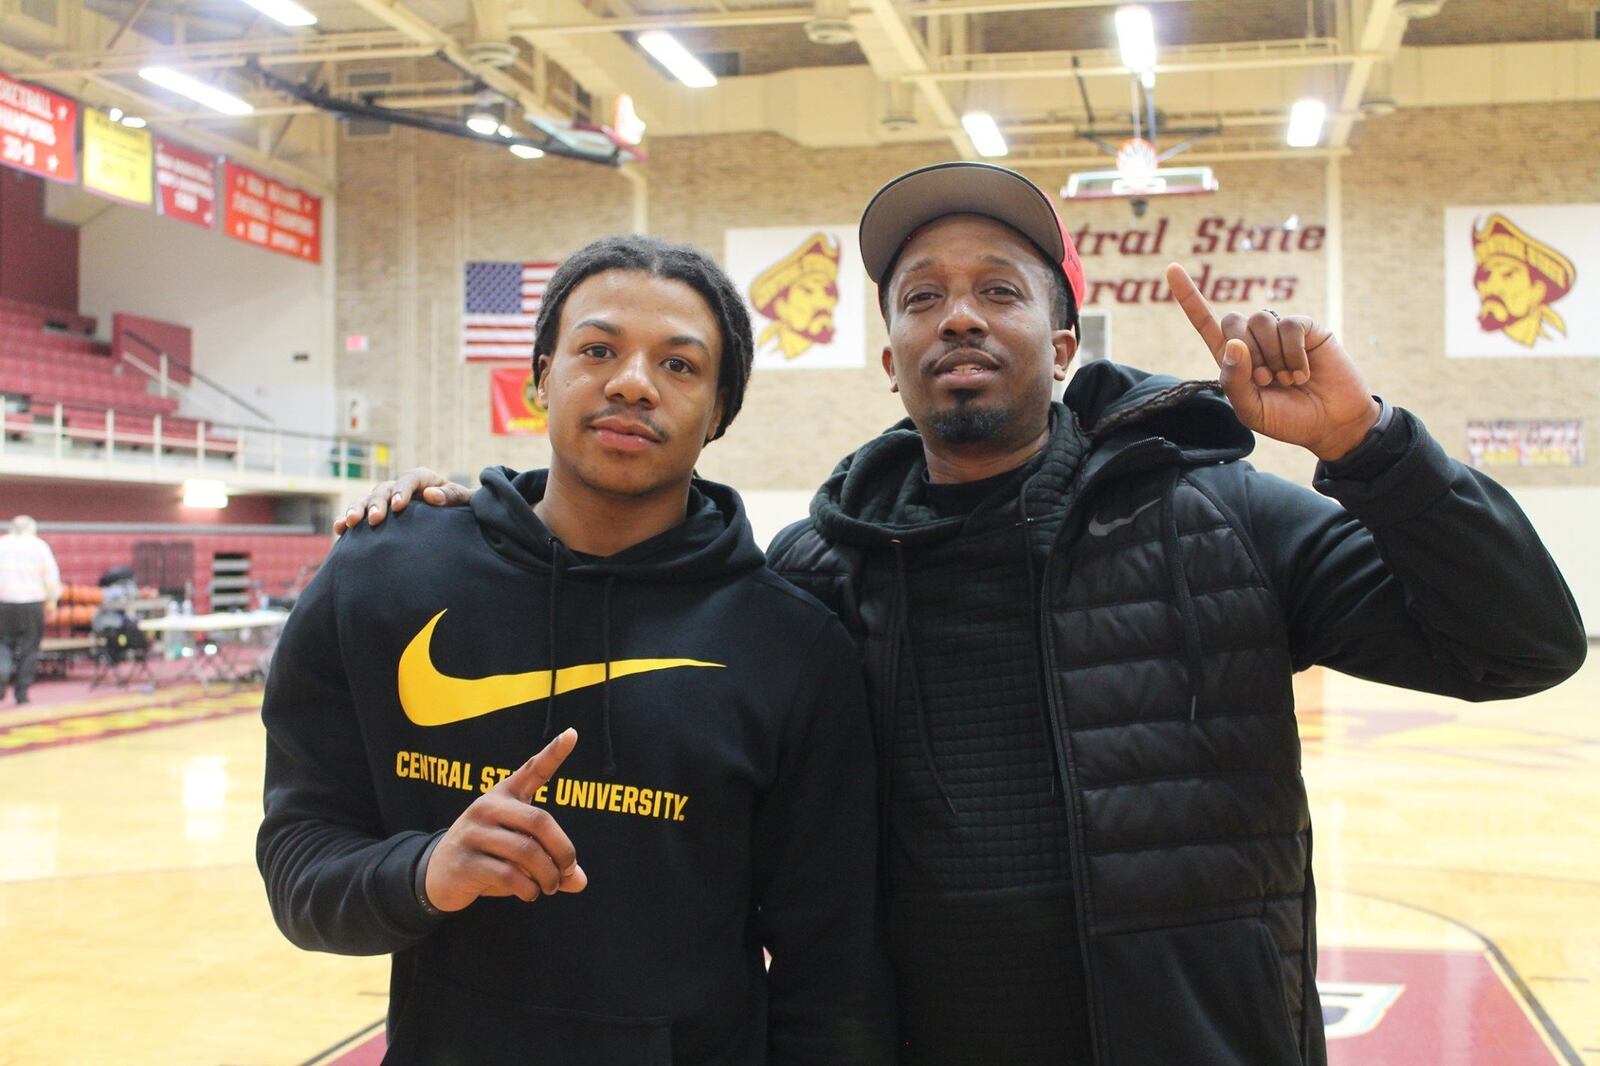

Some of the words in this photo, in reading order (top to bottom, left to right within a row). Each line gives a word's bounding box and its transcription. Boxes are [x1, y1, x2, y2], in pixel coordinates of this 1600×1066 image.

[1075, 217, 1169, 256] tral
[1191, 216, 1326, 253] State
[1088, 263, 1299, 304] rauders
[396, 750, 474, 791] CENTRAL
[480, 766, 549, 804] STE
